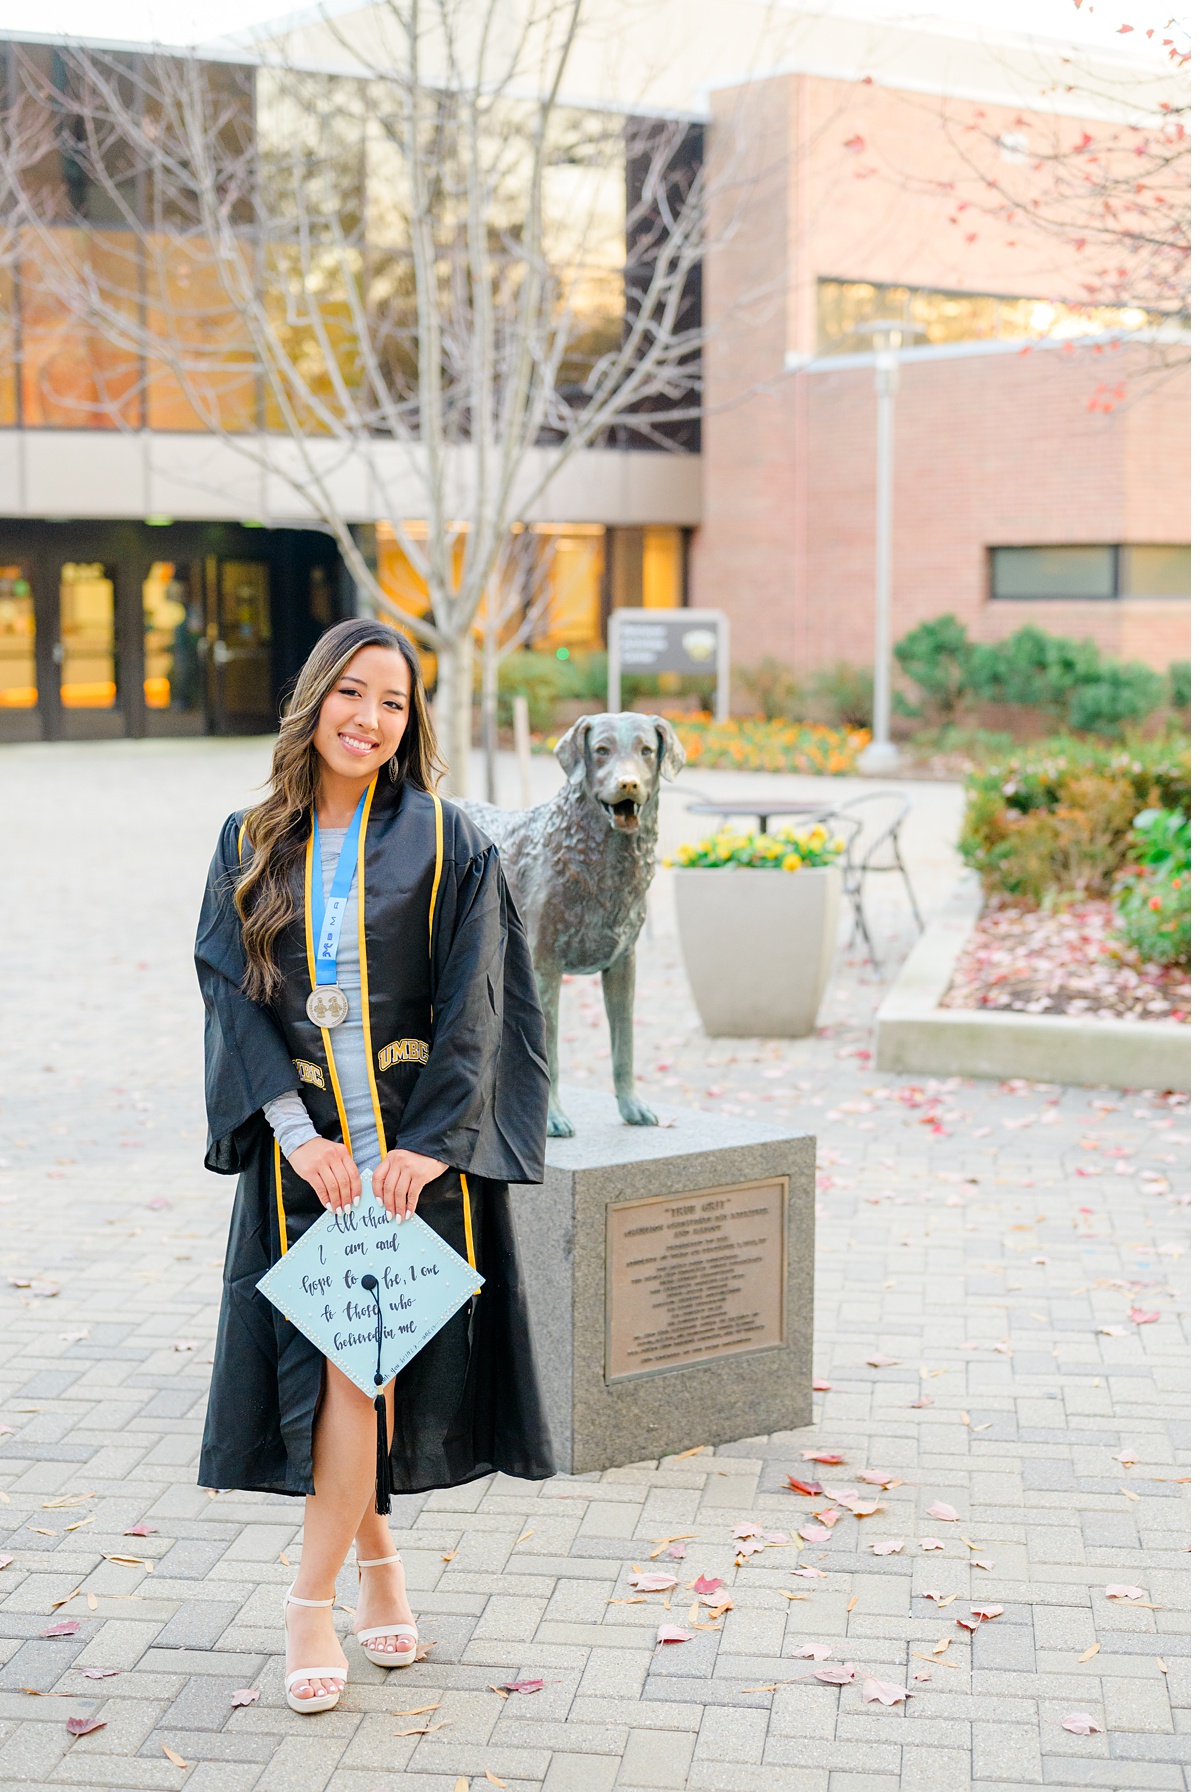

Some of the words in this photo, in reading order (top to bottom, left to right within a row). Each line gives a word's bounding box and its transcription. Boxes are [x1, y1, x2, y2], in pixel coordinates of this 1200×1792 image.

[378, 1038, 429, 1071] UMBC
[327, 1212, 358, 1233] All
[345, 1240, 368, 1256] am
[375, 1233, 399, 1252] and
[300, 1275, 332, 1296] hope
[343, 1270, 358, 1289] to
[382, 1267, 407, 1289] be,
[321, 1305, 336, 1322] to
[343, 1301, 379, 1322] those
[389, 1294, 416, 1311] who
[334, 1328, 379, 1351] believed
[383, 1326, 396, 1339] in
[398, 1321, 417, 1334] me
